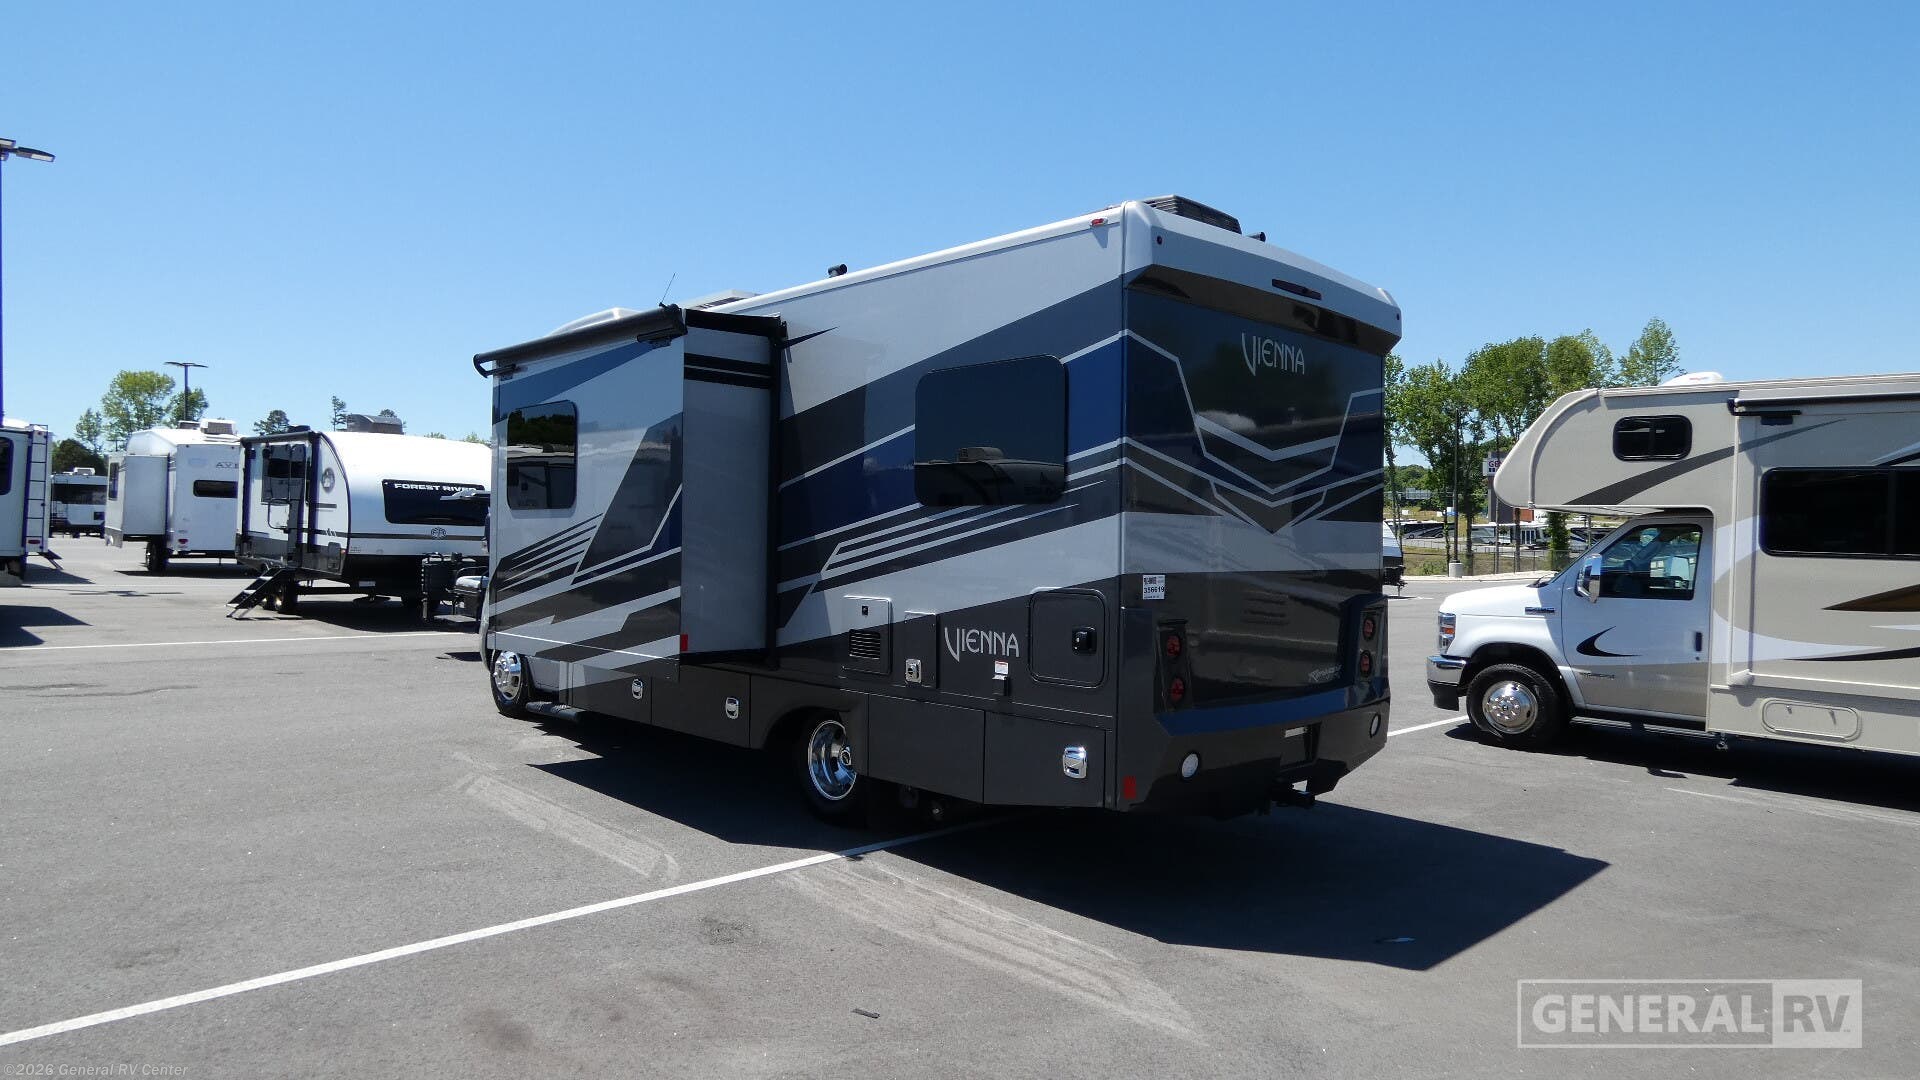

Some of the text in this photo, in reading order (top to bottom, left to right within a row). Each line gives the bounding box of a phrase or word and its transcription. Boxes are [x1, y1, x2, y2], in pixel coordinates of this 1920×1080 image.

[1241, 332, 1305, 376] VIENNA
[394, 483, 440, 491] FOREST
[944, 627, 1020, 662] VIENNA
